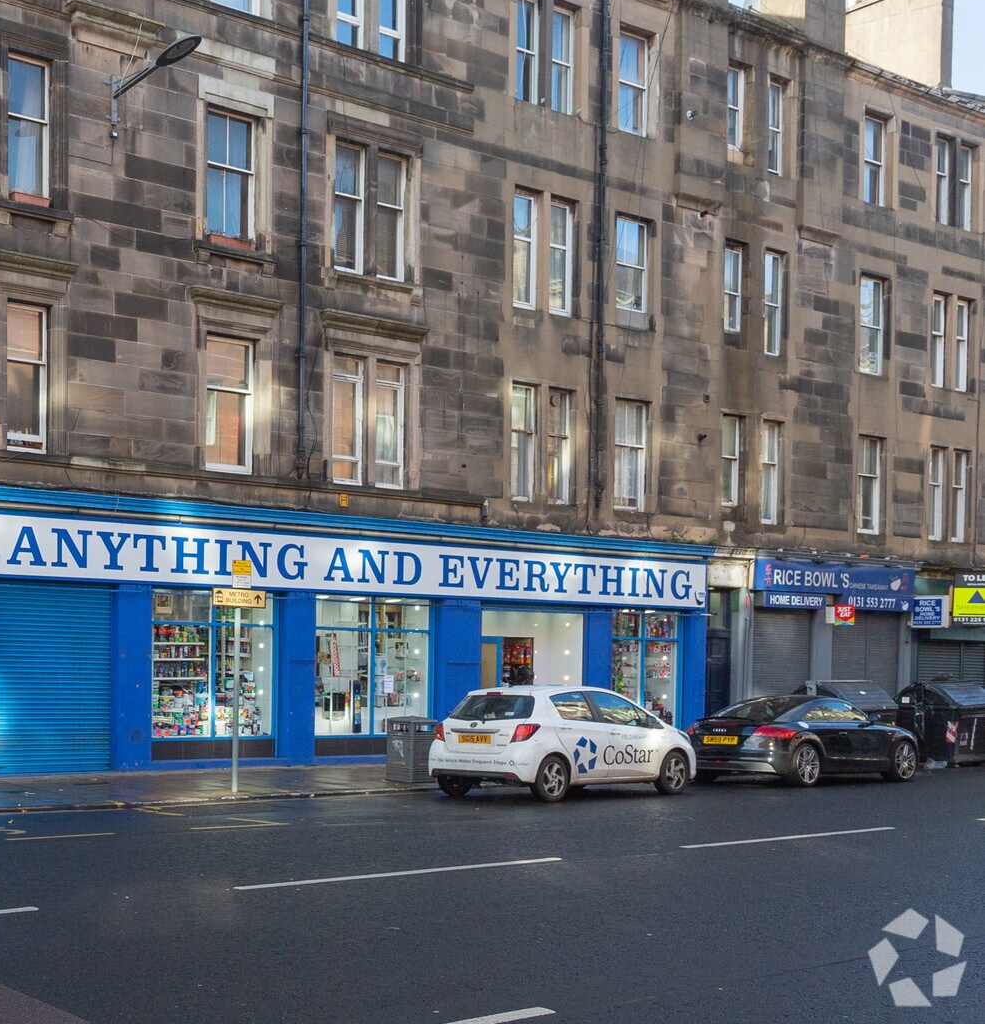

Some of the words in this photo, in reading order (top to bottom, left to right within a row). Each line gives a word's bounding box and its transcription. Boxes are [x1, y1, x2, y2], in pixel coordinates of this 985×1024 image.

[7, 526, 308, 581] ANYTHING
[324, 547, 422, 586] AND
[439, 554, 692, 601] EVERYTHING
[773, 569, 801, 586] RICE
[804, 571, 838, 587] BOWL
[769, 595, 791, 605] HOME
[791, 595, 823, 606] DELIVERY
[848, 596, 864, 608] 0131
[866, 597, 879, 608] 553
[879, 598, 896, 609] 2777
[603, 744, 653, 766] CoStar
